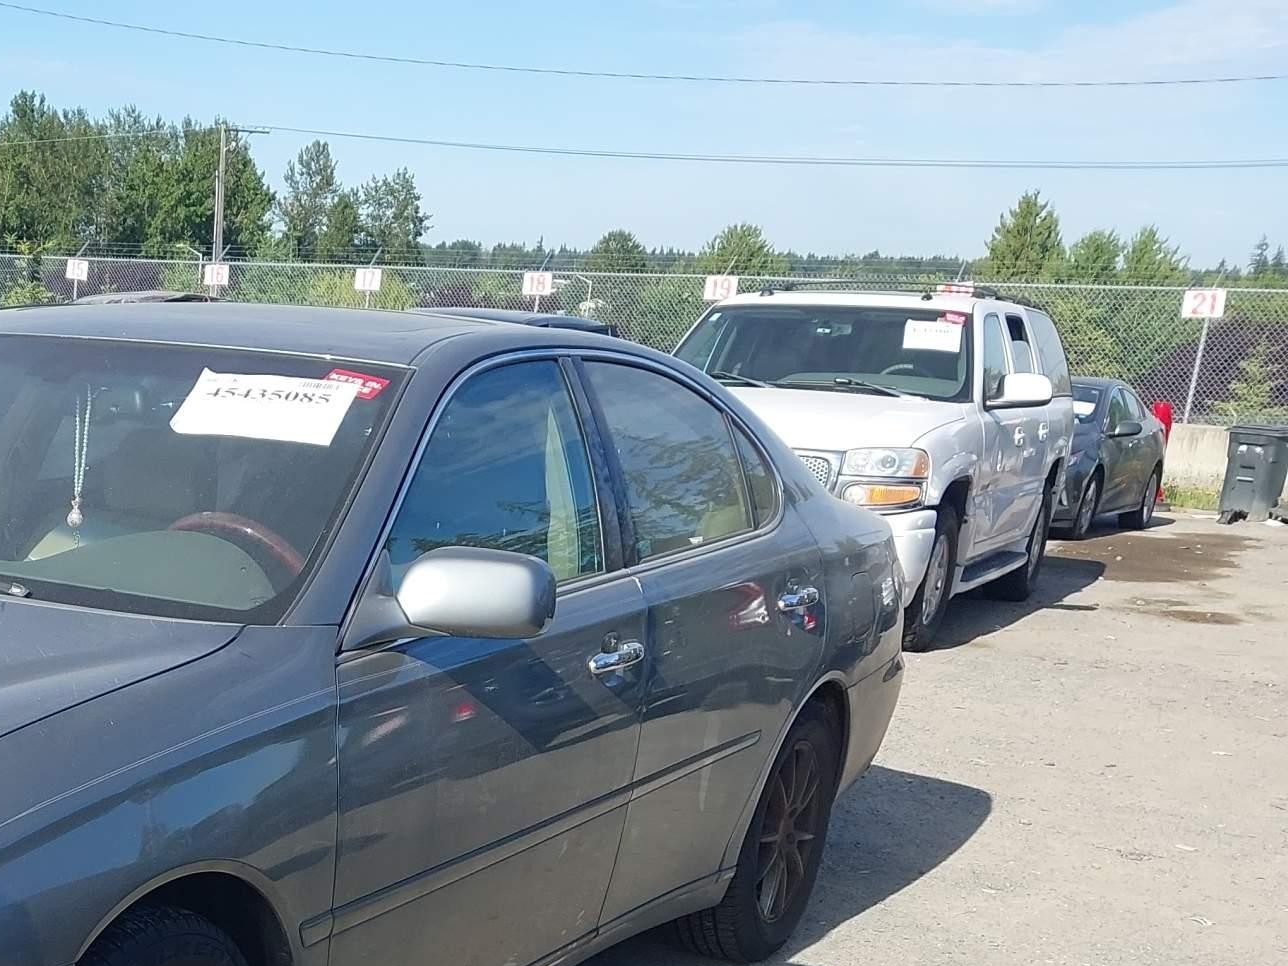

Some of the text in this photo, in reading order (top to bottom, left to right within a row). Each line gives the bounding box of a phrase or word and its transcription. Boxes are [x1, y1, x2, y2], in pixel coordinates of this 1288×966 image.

[71, 261, 84, 278] 15
[211, 266, 224, 283] 16
[362, 270, 376, 288] 17
[529, 273, 546, 293] 18
[712, 277, 732, 299] 19
[1192, 292, 1217, 315] 21
[206, 387, 332, 404] 45435085
